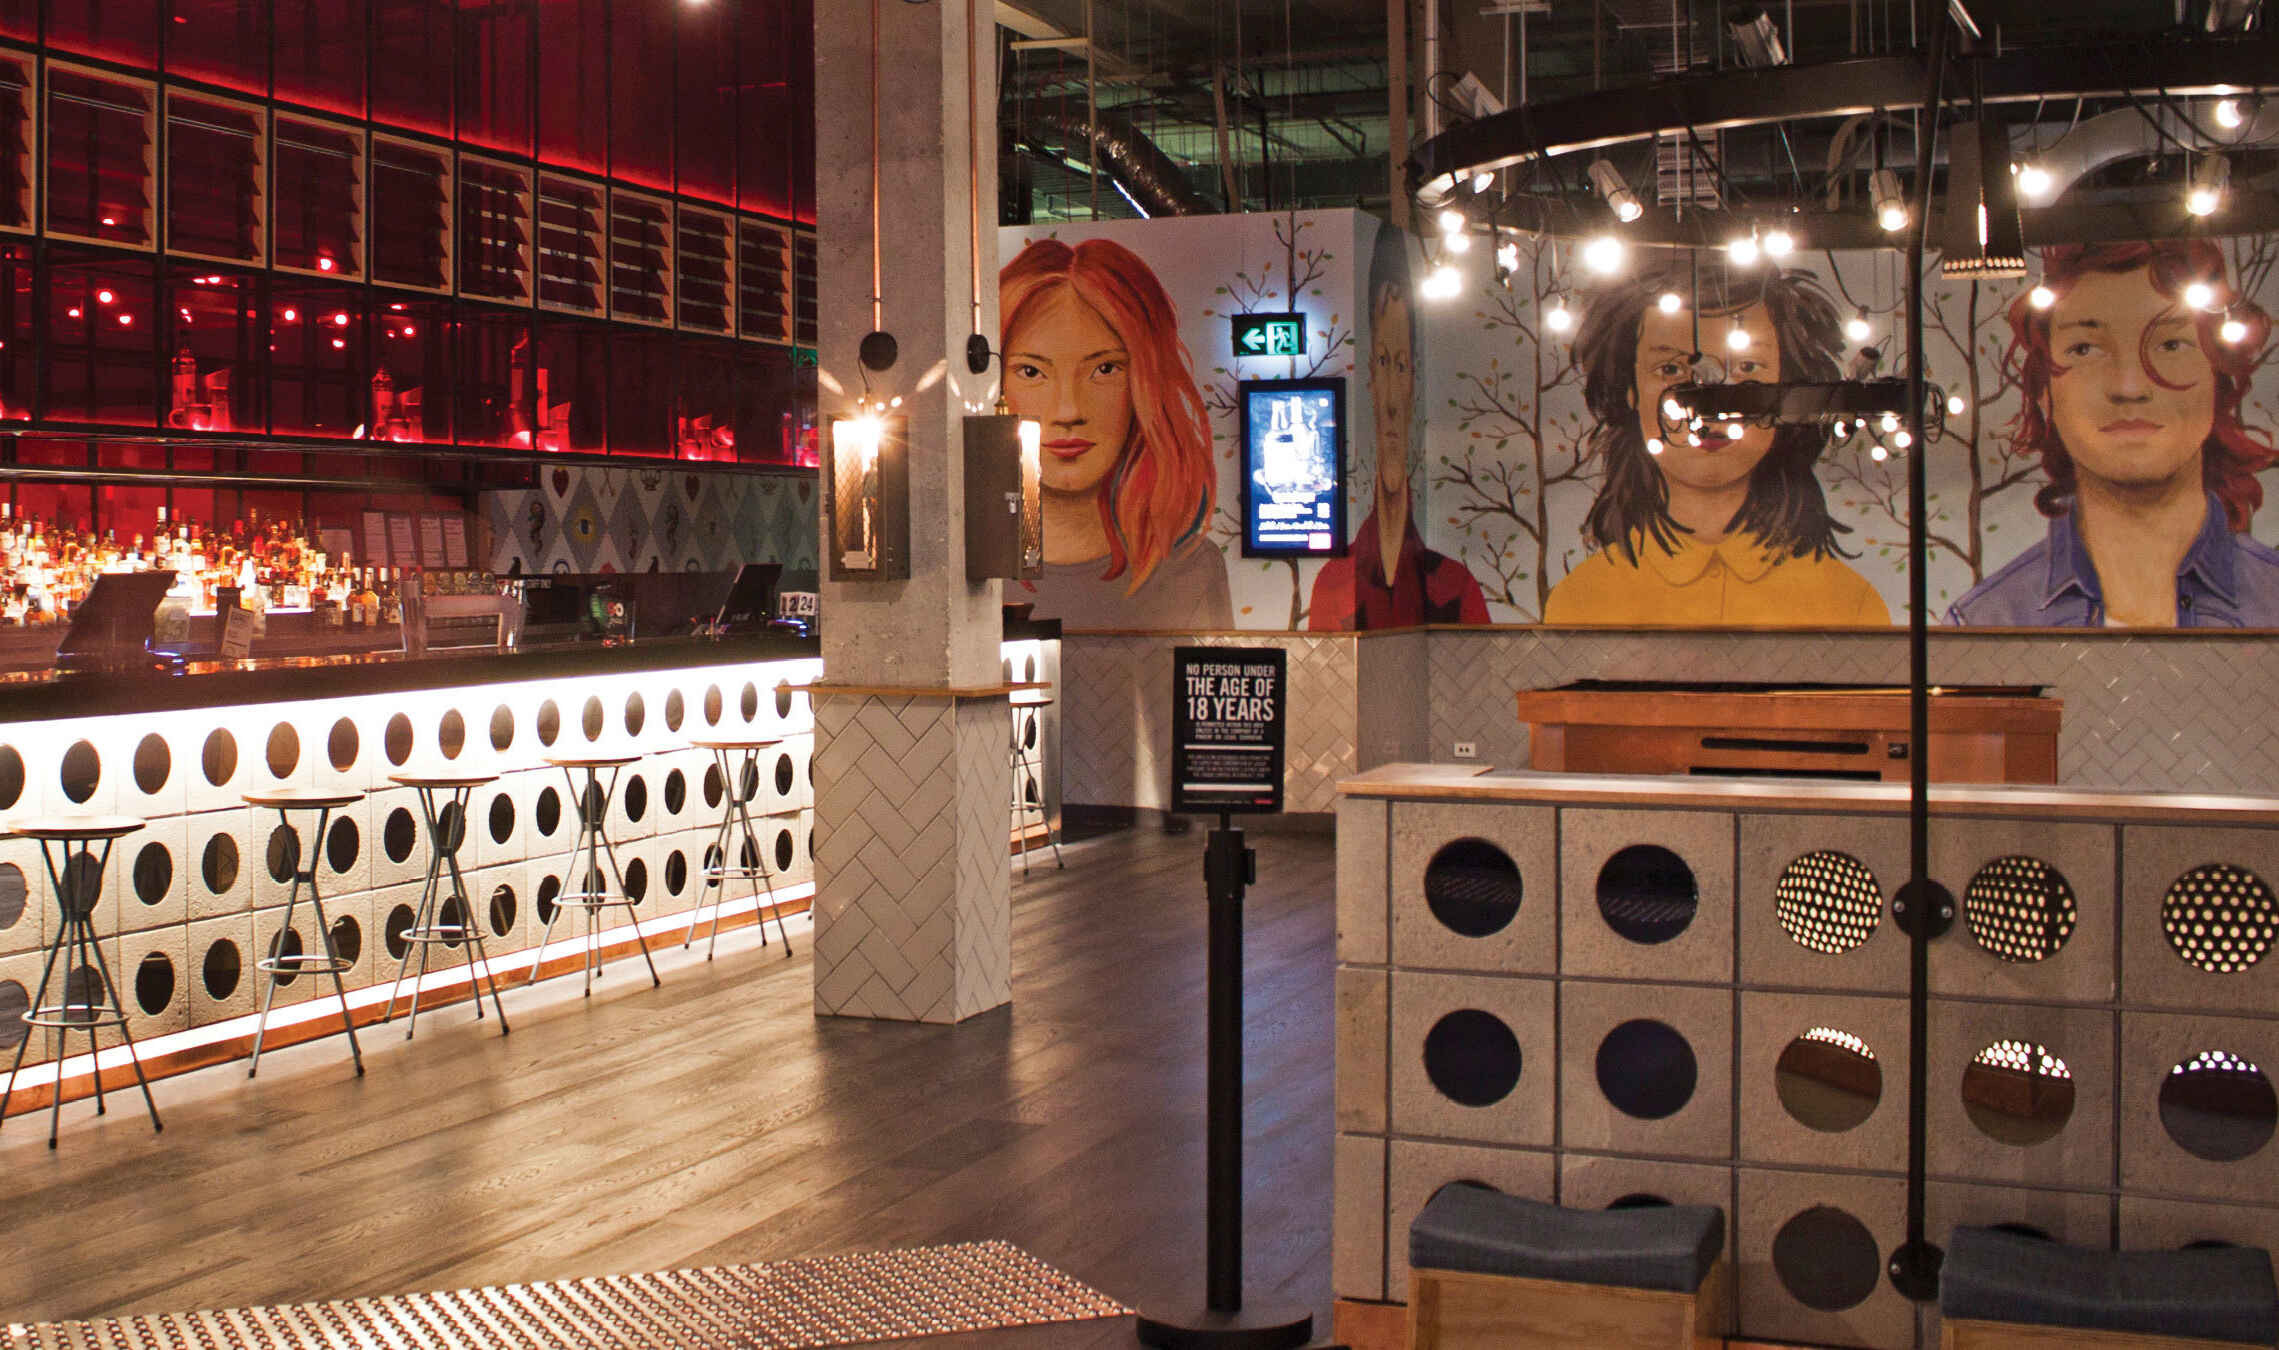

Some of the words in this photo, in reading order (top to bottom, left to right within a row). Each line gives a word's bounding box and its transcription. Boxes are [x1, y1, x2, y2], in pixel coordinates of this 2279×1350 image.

[1186, 664, 1200, 676] NO
[1203, 664, 1241, 677] PERSON
[1243, 665, 1276, 677] UNDER
[1186, 677, 1215, 696] THE
[1219, 678, 1250, 697] AGE
[1255, 678, 1275, 697] OF
[1187, 697, 1209, 720] 18
[1213, 697, 1275, 721] YEARS
